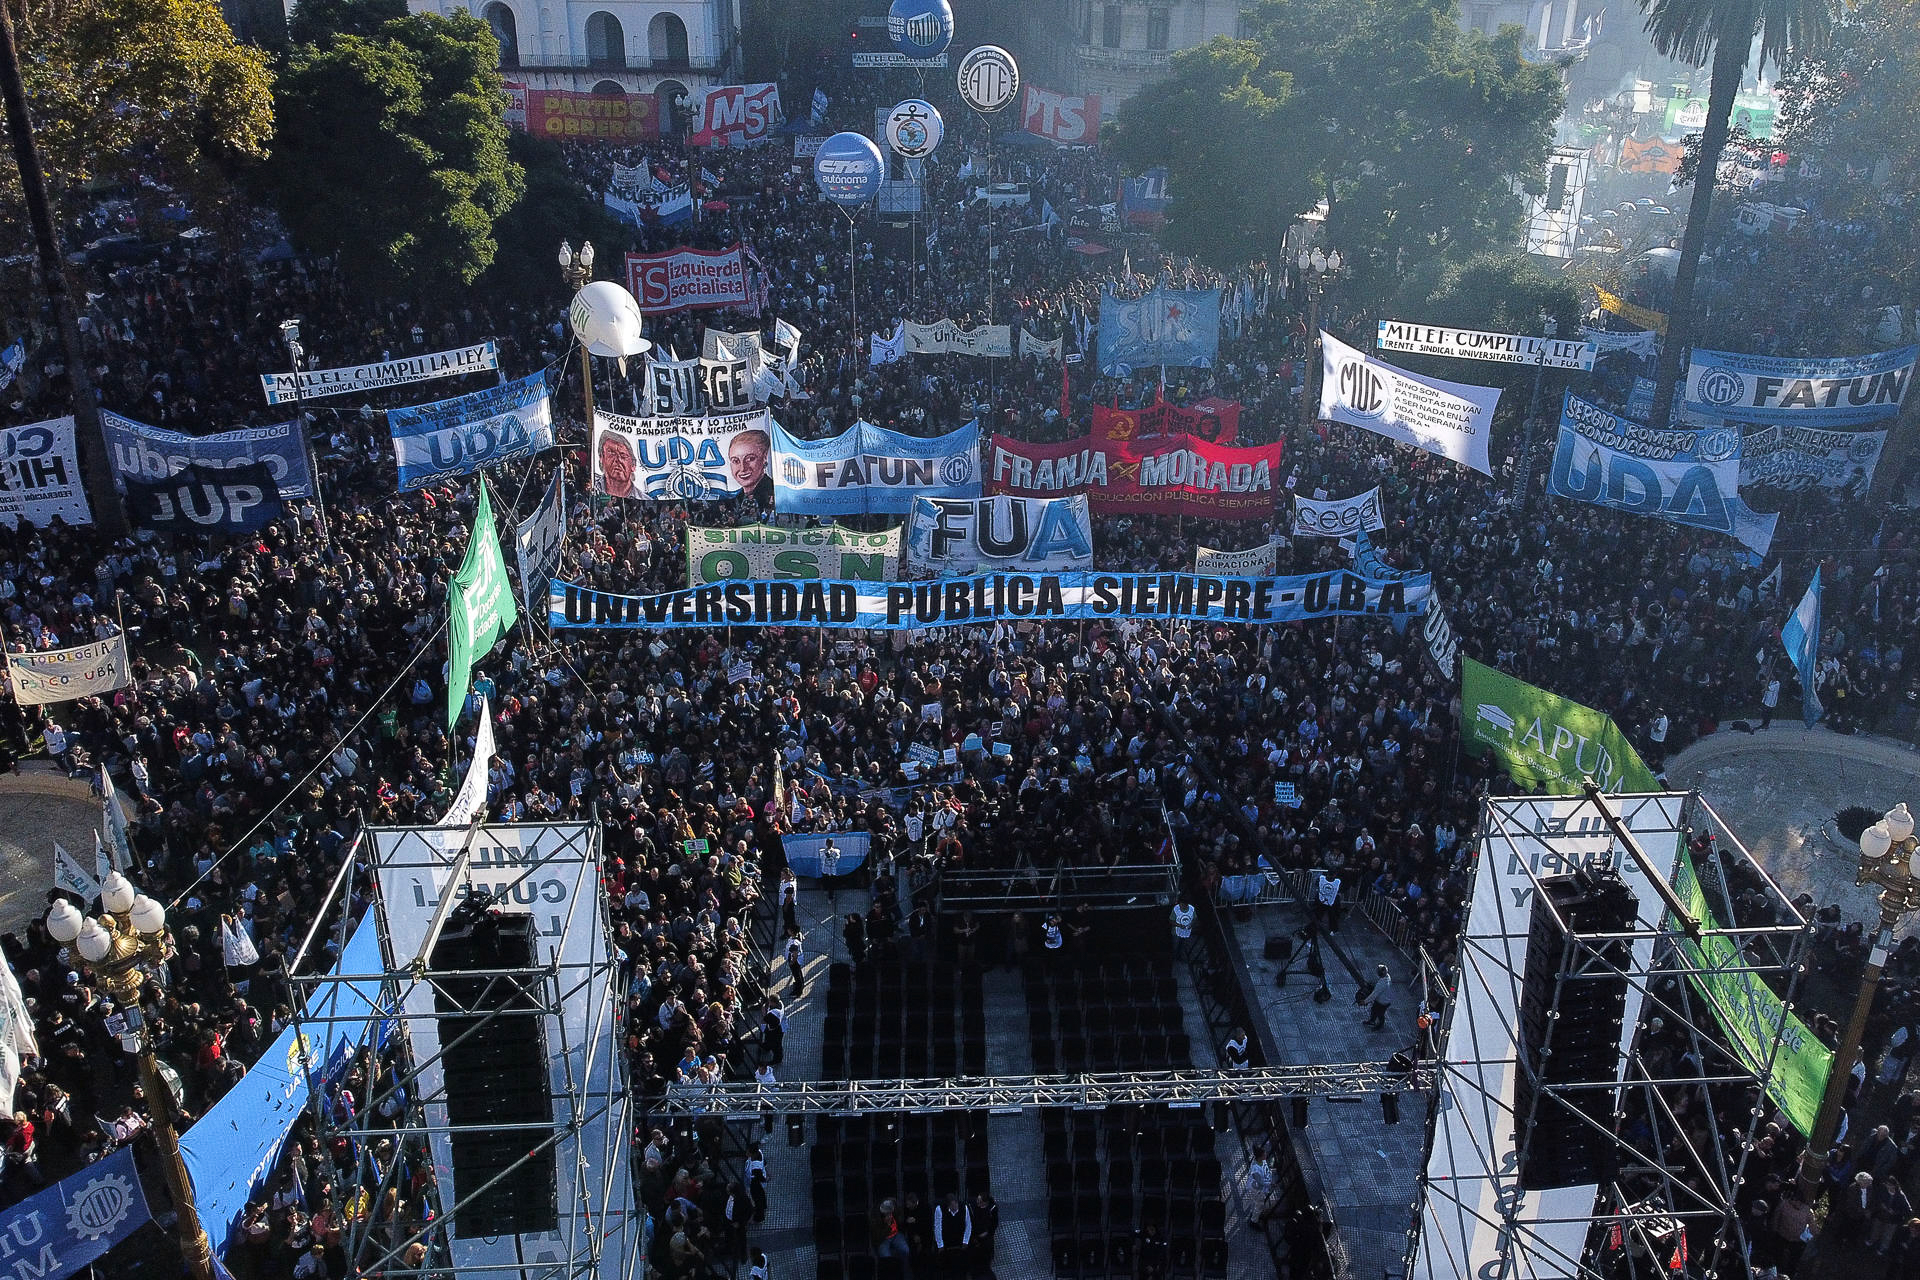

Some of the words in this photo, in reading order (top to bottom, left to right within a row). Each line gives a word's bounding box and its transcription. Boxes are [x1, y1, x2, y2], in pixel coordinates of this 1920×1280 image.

[970, 62, 1007, 102] ATE
[544, 96, 649, 118] PARTIDO
[1024, 86, 1087, 140] PTS
[546, 117, 642, 137] OBRERO
[822, 174, 868, 184] autónoma
[669, 260, 740, 281] izquierda
[671, 280, 743, 299] socialista
[1384, 340, 1414, 351] FRENTE
[1418, 345, 1455, 356] SINDICAL
[1458, 349, 1524, 363] UNIVERSITARIO
[1534, 356, 1552, 366] CN
[1560, 359, 1580, 369] FUA
[1385, 324, 1450, 345] MILEI:
[1455, 332, 1520, 354] CUMPLI
[1552, 342, 1585, 360] LEY
[430, 355, 450, 371] LA
[456, 346, 485, 368] LEY
[318, 382, 359, 396] SINDICAL
[654, 360, 748, 414] SURGE
[1340, 362, 1383, 412] MUC
[1752, 366, 1910, 408] FATUN
[1394, 388, 1446, 408] PATRIOTAS
[1447, 402, 1462, 411] NO
[1462, 404, 1482, 415] VAN
[1402, 399, 1419, 409] SER
[1419, 404, 1445, 417] NADA
[1446, 411, 1458, 420] EN
[1459, 414, 1471, 424] LA
[609, 422, 633, 434] COMO
[636, 425, 679, 436] BANDERA
[681, 426, 689, 435] A
[691, 425, 704, 435] LA
[708, 424, 748, 435] VICTORIA
[641, 420, 652, 429] MI
[656, 419, 694, 429] NOMBRE
[698, 419, 704, 427] Y
[708, 418, 720, 427] LO
[723, 410, 766, 425] LLEVARAN
[1416, 412, 1455, 429] QUIERAN
[1463, 425, 1476, 435] SU
[1566, 395, 1617, 432] SERGIO
[1625, 423, 1699, 453] ROMERO
[427, 414, 532, 472] UDA
[637, 435, 726, 469] UDA
[1576, 422, 1677, 460] CONDUCCION
[816, 454, 934, 488] FATUN
[993, 446, 1108, 491] FRANJA
[1139, 448, 1272, 493] MORADA
[1551, 426, 1732, 532] UDA
[1218, 496, 1271, 509] SIEMPRE
[703, 529, 889, 547] SINDICATO
[929, 500, 1092, 561] FUA
[1197, 556, 1271, 569] OCUPACIONAL
[1208, 551, 1258, 560] TERAPIA
[565, 581, 858, 625] UNIVERSIDAD
[887, 575, 1065, 626] PUBLICA
[1093, 575, 1276, 620] SIEMPRE
[1303, 575, 1418, 615] U.B.A.
[20, 674, 70, 690] PSICO
[84, 663, 116, 681] UBA
[1514, 750, 1526, 763] del
[1527, 755, 1561, 782] Personal
[1561, 774, 1573, 786] de
